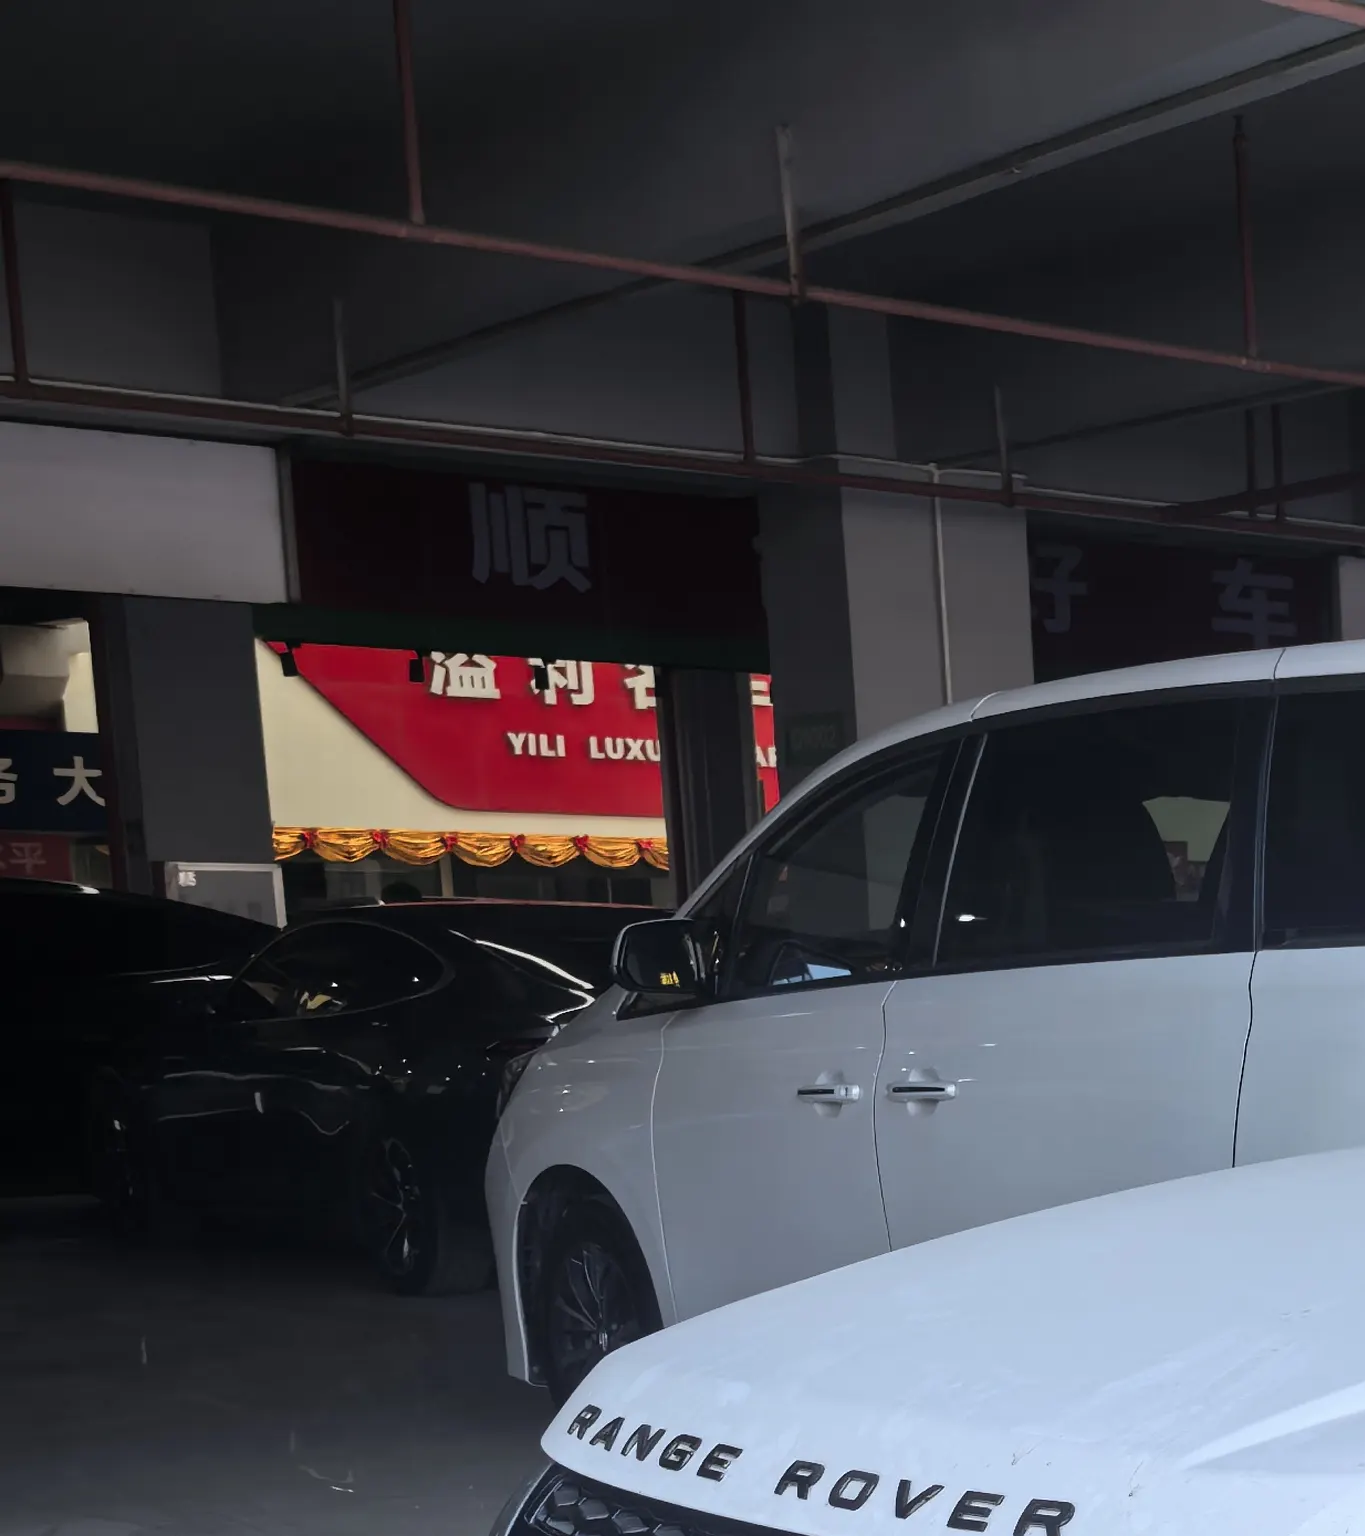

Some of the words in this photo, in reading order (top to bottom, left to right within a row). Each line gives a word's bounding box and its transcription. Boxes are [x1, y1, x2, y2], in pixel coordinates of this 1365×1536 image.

[470, 482, 591, 592] 顺
[507, 732, 566, 758] YILI
[566, 1404, 743, 1483] RANGE
